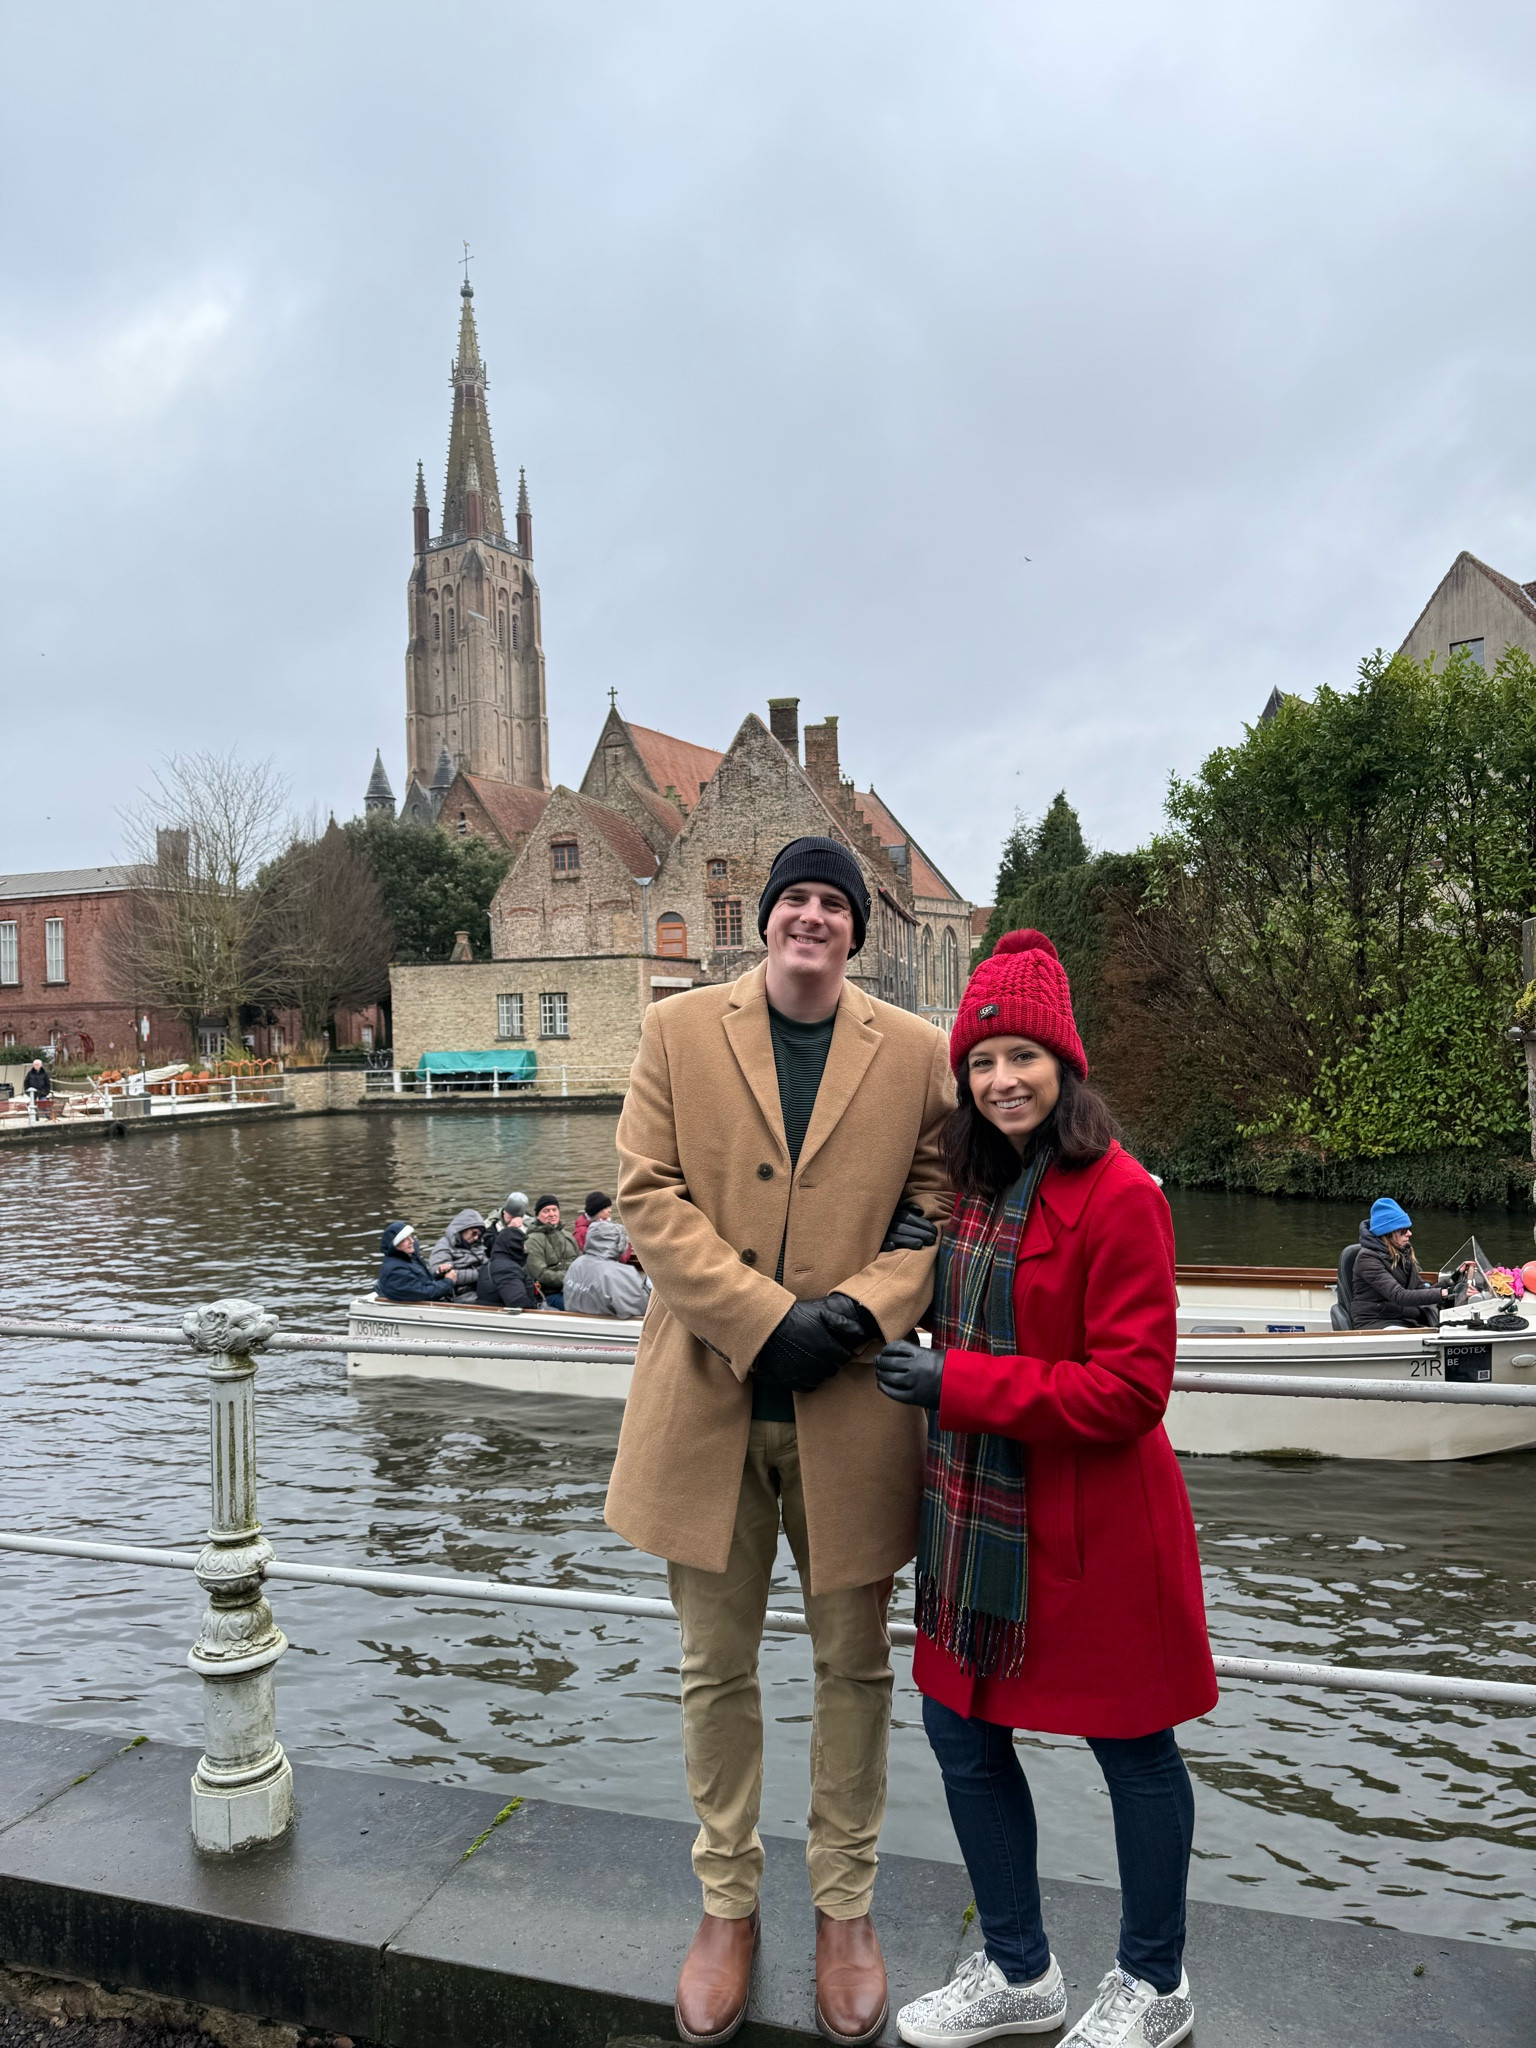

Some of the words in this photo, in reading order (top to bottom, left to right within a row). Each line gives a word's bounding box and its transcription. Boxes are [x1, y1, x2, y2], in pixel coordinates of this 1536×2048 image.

[1447, 1346, 1486, 1355] BOOTEX
[1447, 1358, 1459, 1366] BE
[1410, 1359, 1442, 1377] 21R
